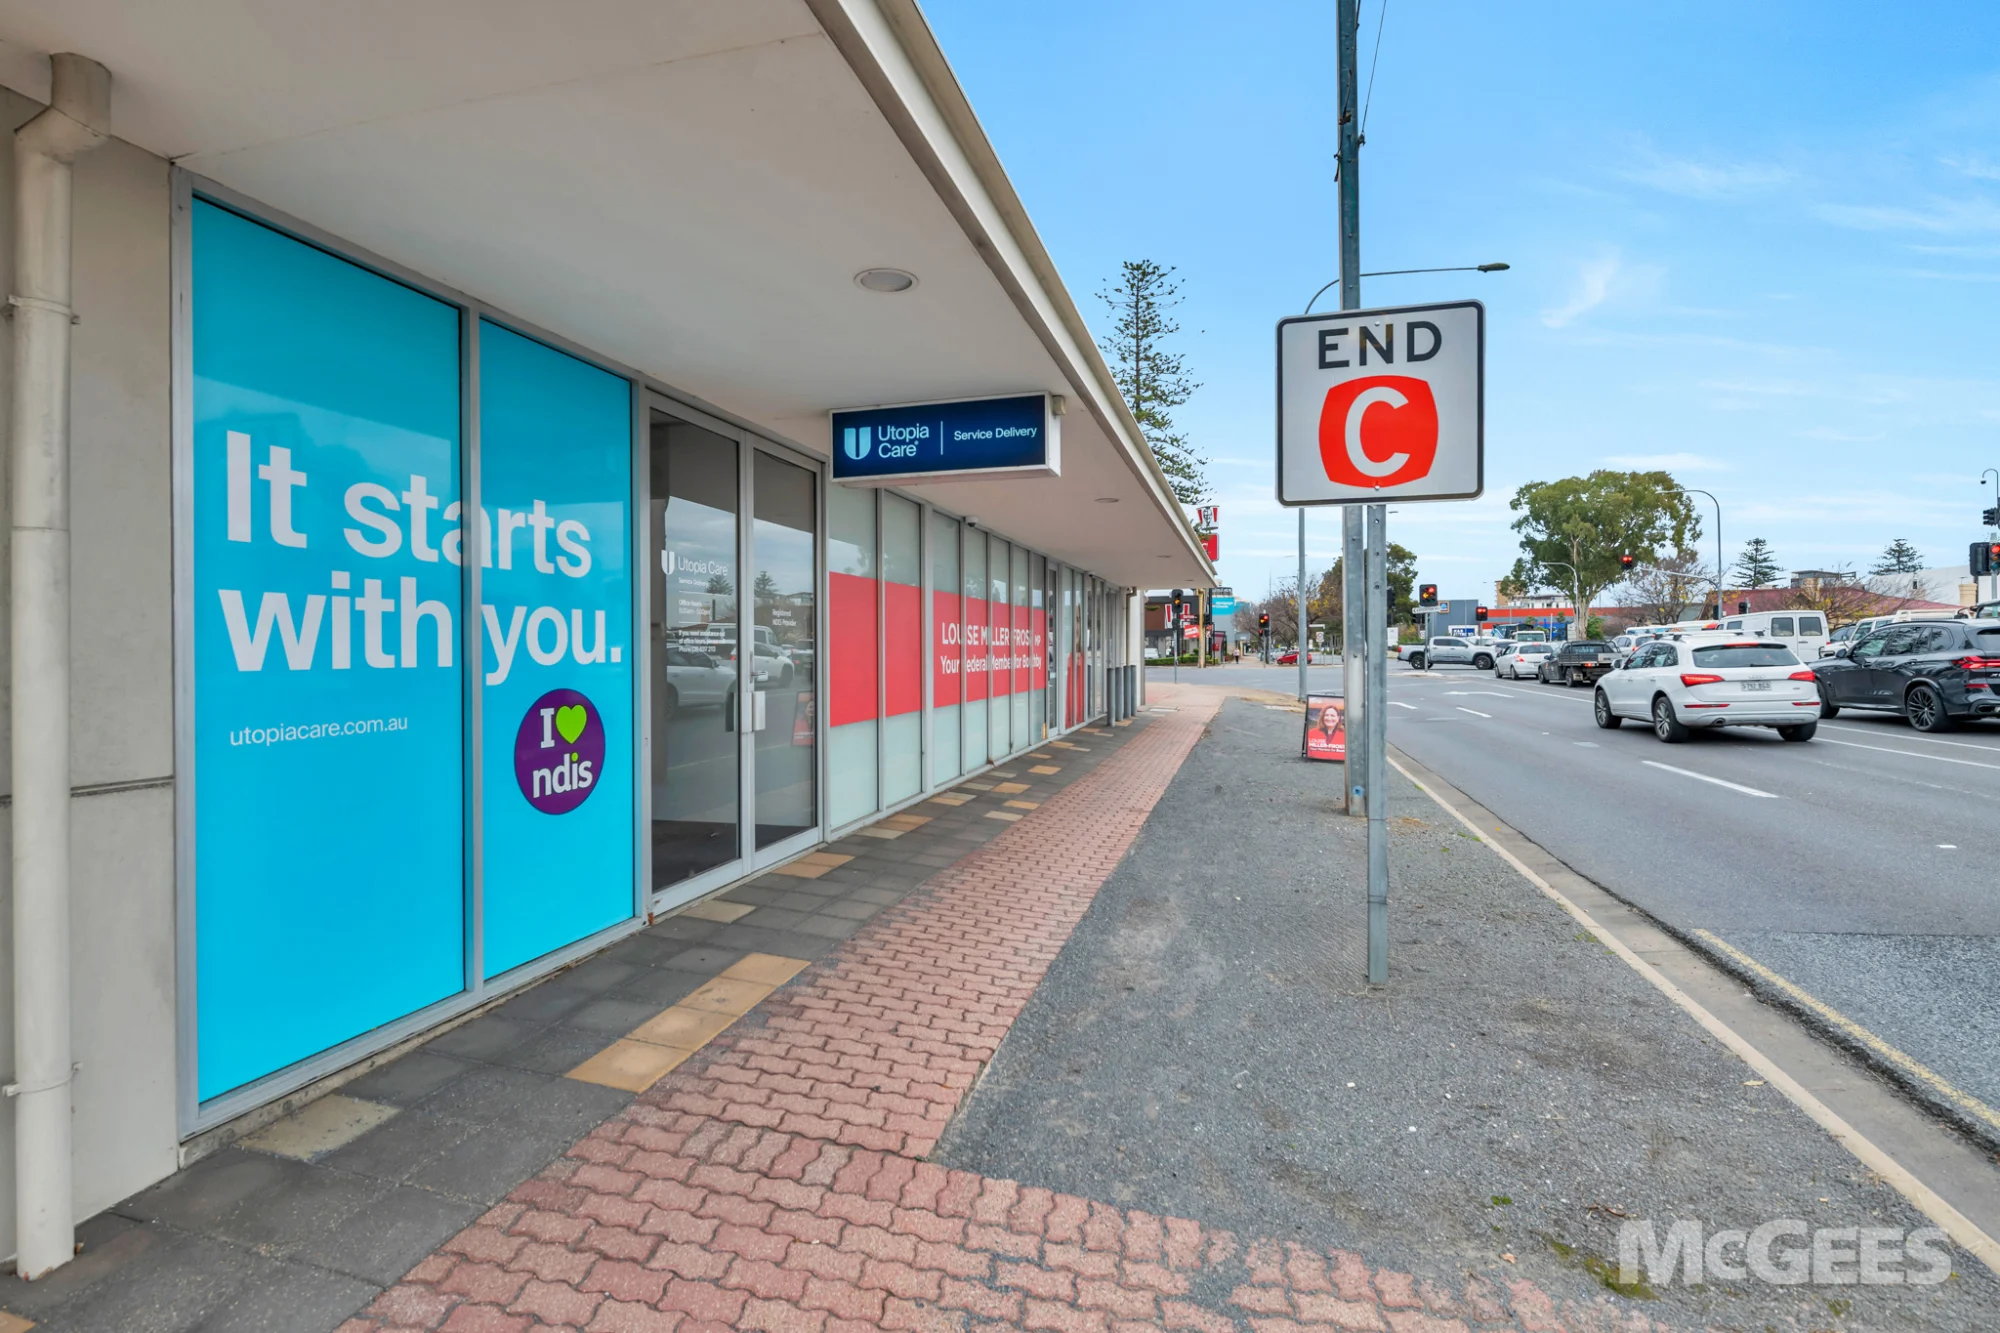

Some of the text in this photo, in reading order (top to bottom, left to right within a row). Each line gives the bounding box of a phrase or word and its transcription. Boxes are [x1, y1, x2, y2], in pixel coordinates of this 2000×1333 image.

[1318, 320, 1442, 370] END
[878, 423, 930, 442] Utopia
[954, 427, 1038, 441] Service Delivery
[1344, 386, 1411, 478] C
[227, 430, 592, 578] It starts
[677, 556, 728, 576] Utopia Care
[218, 571, 622, 686] with you.
[941, 622, 979, 646] LOUSE
[940, 655, 961, 674] Your
[964, 654, 988, 672] ederal
[989, 653, 1011, 670] Membe
[230, 717, 409, 747] utopiacare.com.au
[540, 706, 555, 749] I
[532, 751, 593, 798] ndis
